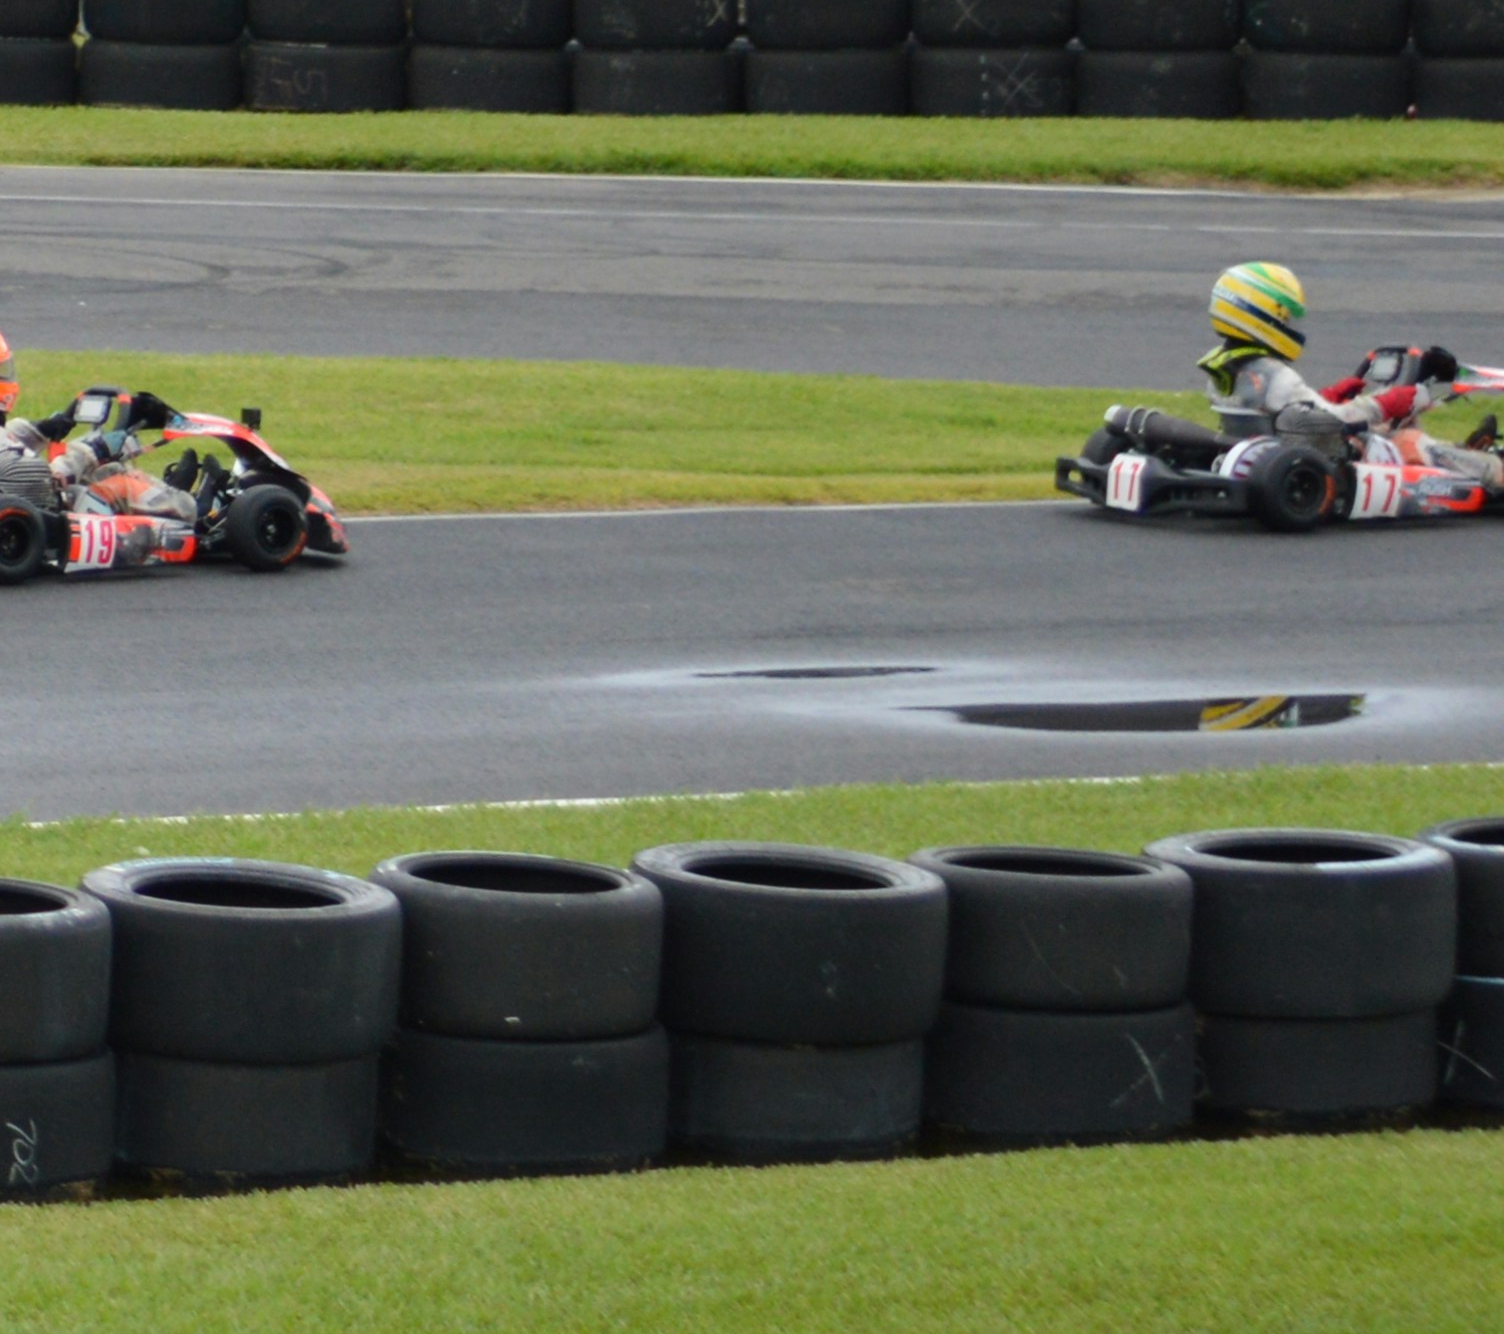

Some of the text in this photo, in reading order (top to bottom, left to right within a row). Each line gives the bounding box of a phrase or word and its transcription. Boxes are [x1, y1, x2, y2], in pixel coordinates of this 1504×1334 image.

[1113, 461, 1142, 503] 17
[1362, 473, 1397, 513] 17
[85, 519, 114, 564] 19
